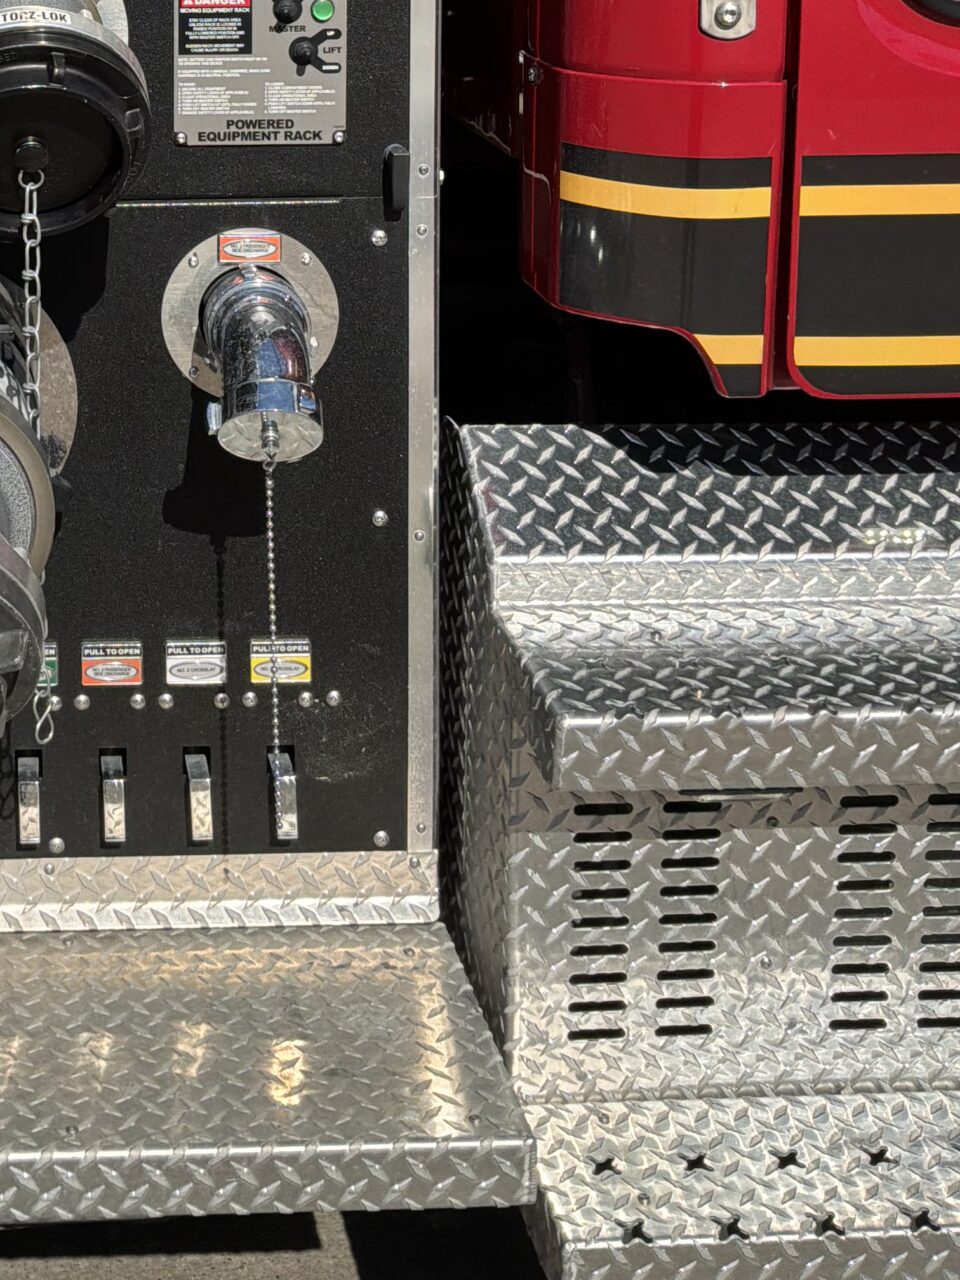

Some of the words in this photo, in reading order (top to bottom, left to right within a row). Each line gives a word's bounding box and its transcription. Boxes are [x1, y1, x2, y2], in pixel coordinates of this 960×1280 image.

[322, 46, 343, 54] LIFT
[226, 119, 295, 130] POWERED
[198, 131, 281, 142] EQUIPMENT
[283, 130, 323, 141] RACK
[84, 648, 105, 656] PULL
